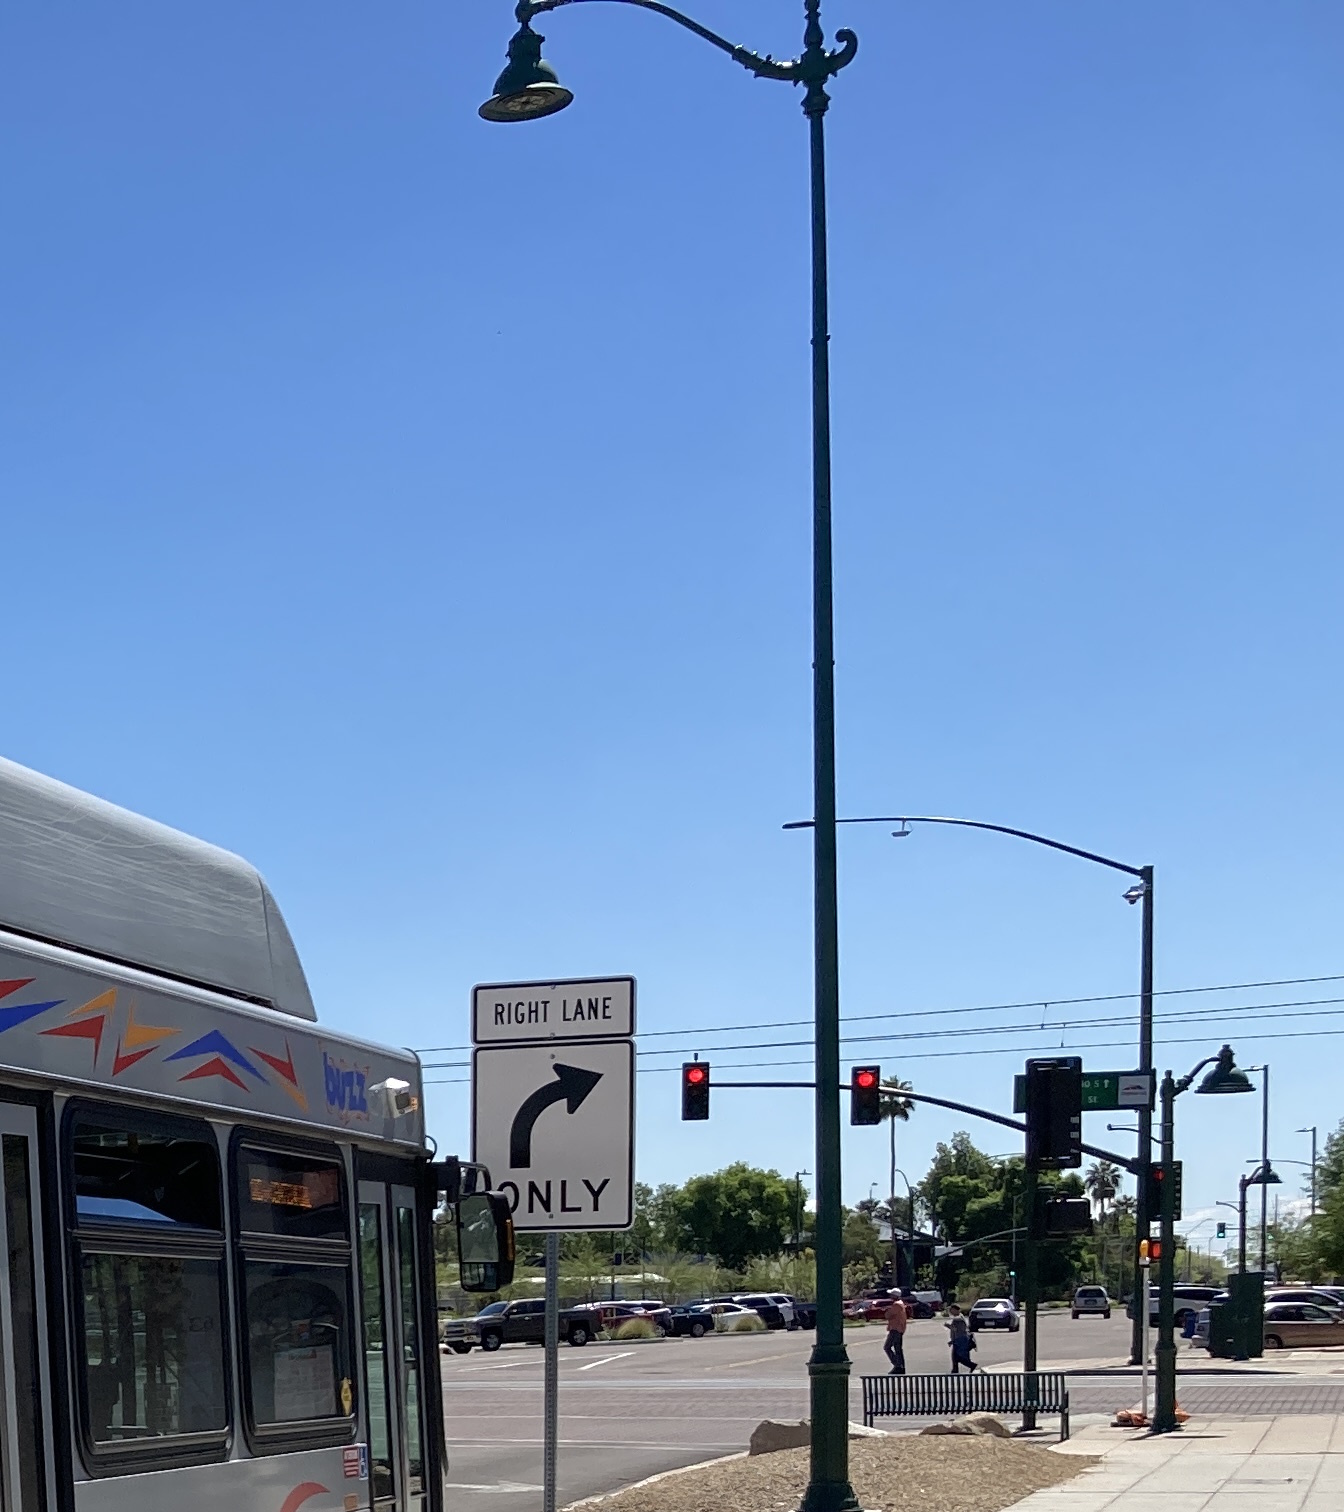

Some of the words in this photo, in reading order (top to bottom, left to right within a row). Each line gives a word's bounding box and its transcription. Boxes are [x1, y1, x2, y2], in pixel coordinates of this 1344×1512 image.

[494, 1000, 551, 1026] RIGHT
[562, 996, 612, 1022] LANE
[497, 1177, 611, 1214] ONLY
